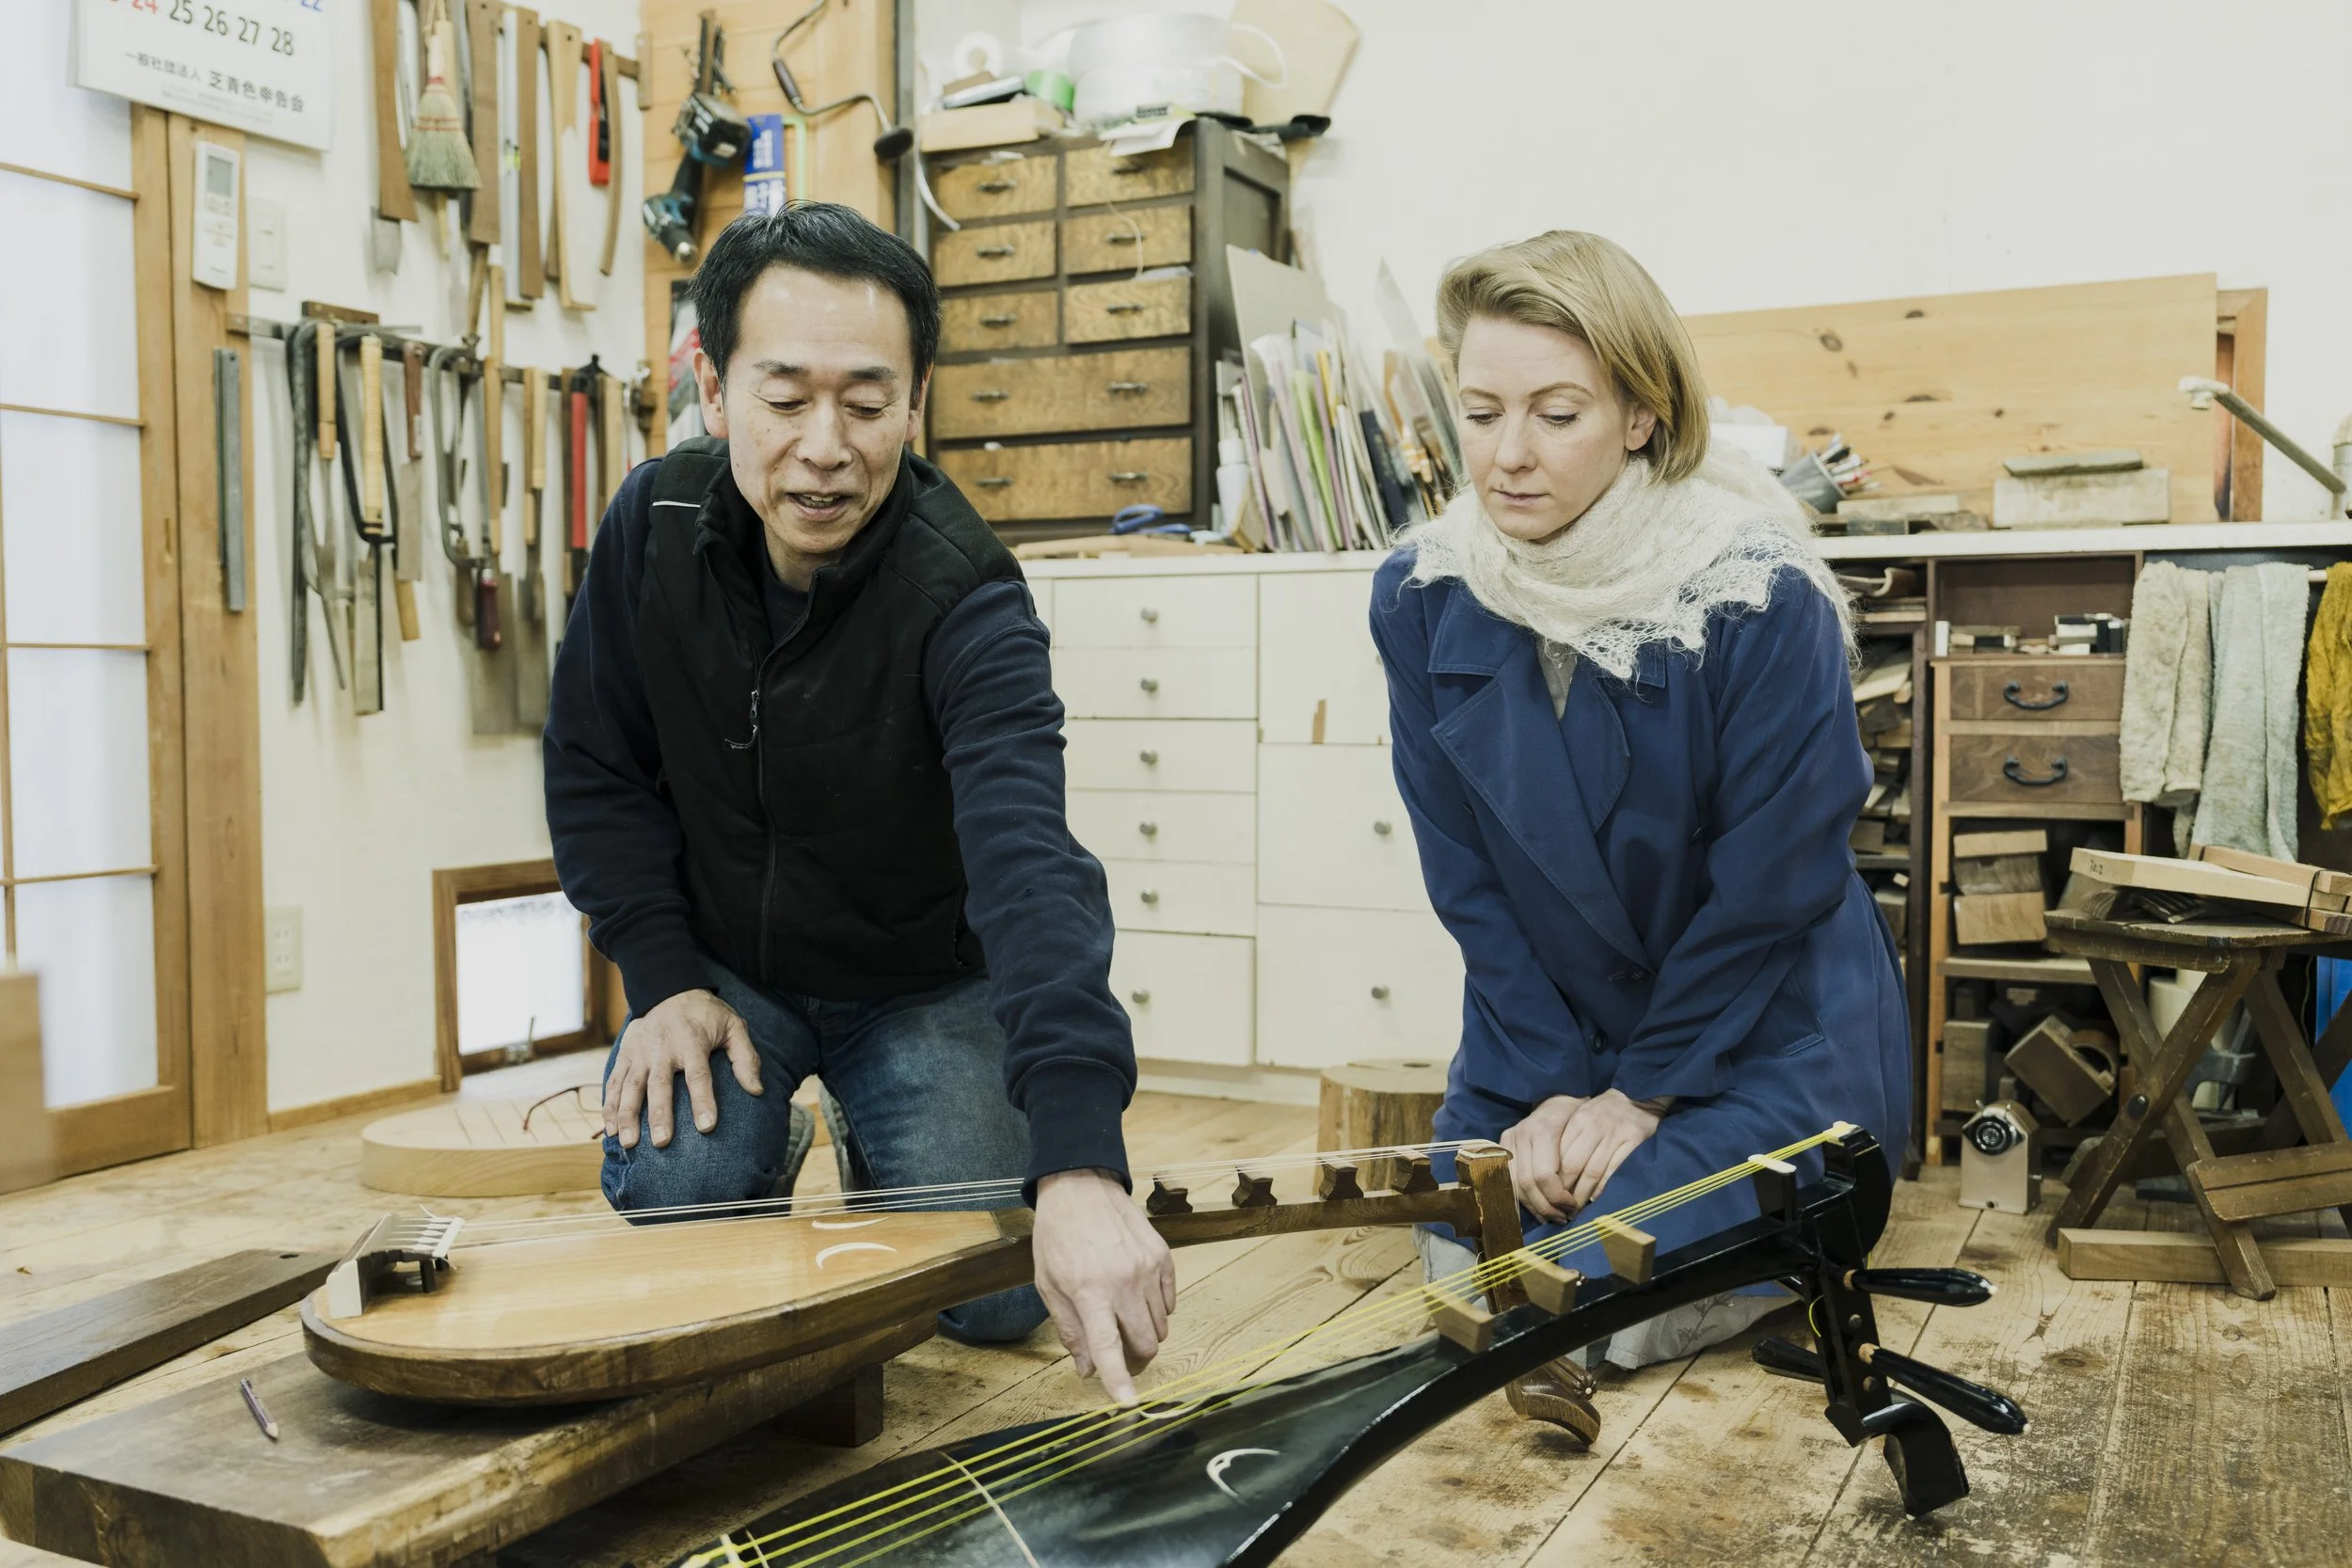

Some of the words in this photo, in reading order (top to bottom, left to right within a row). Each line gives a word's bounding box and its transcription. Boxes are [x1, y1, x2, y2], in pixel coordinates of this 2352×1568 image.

[169, 0, 193, 25] 25
[203, 5, 228, 37] 26
[238, 16, 260, 45] 27
[271, 27, 294, 56] 28
